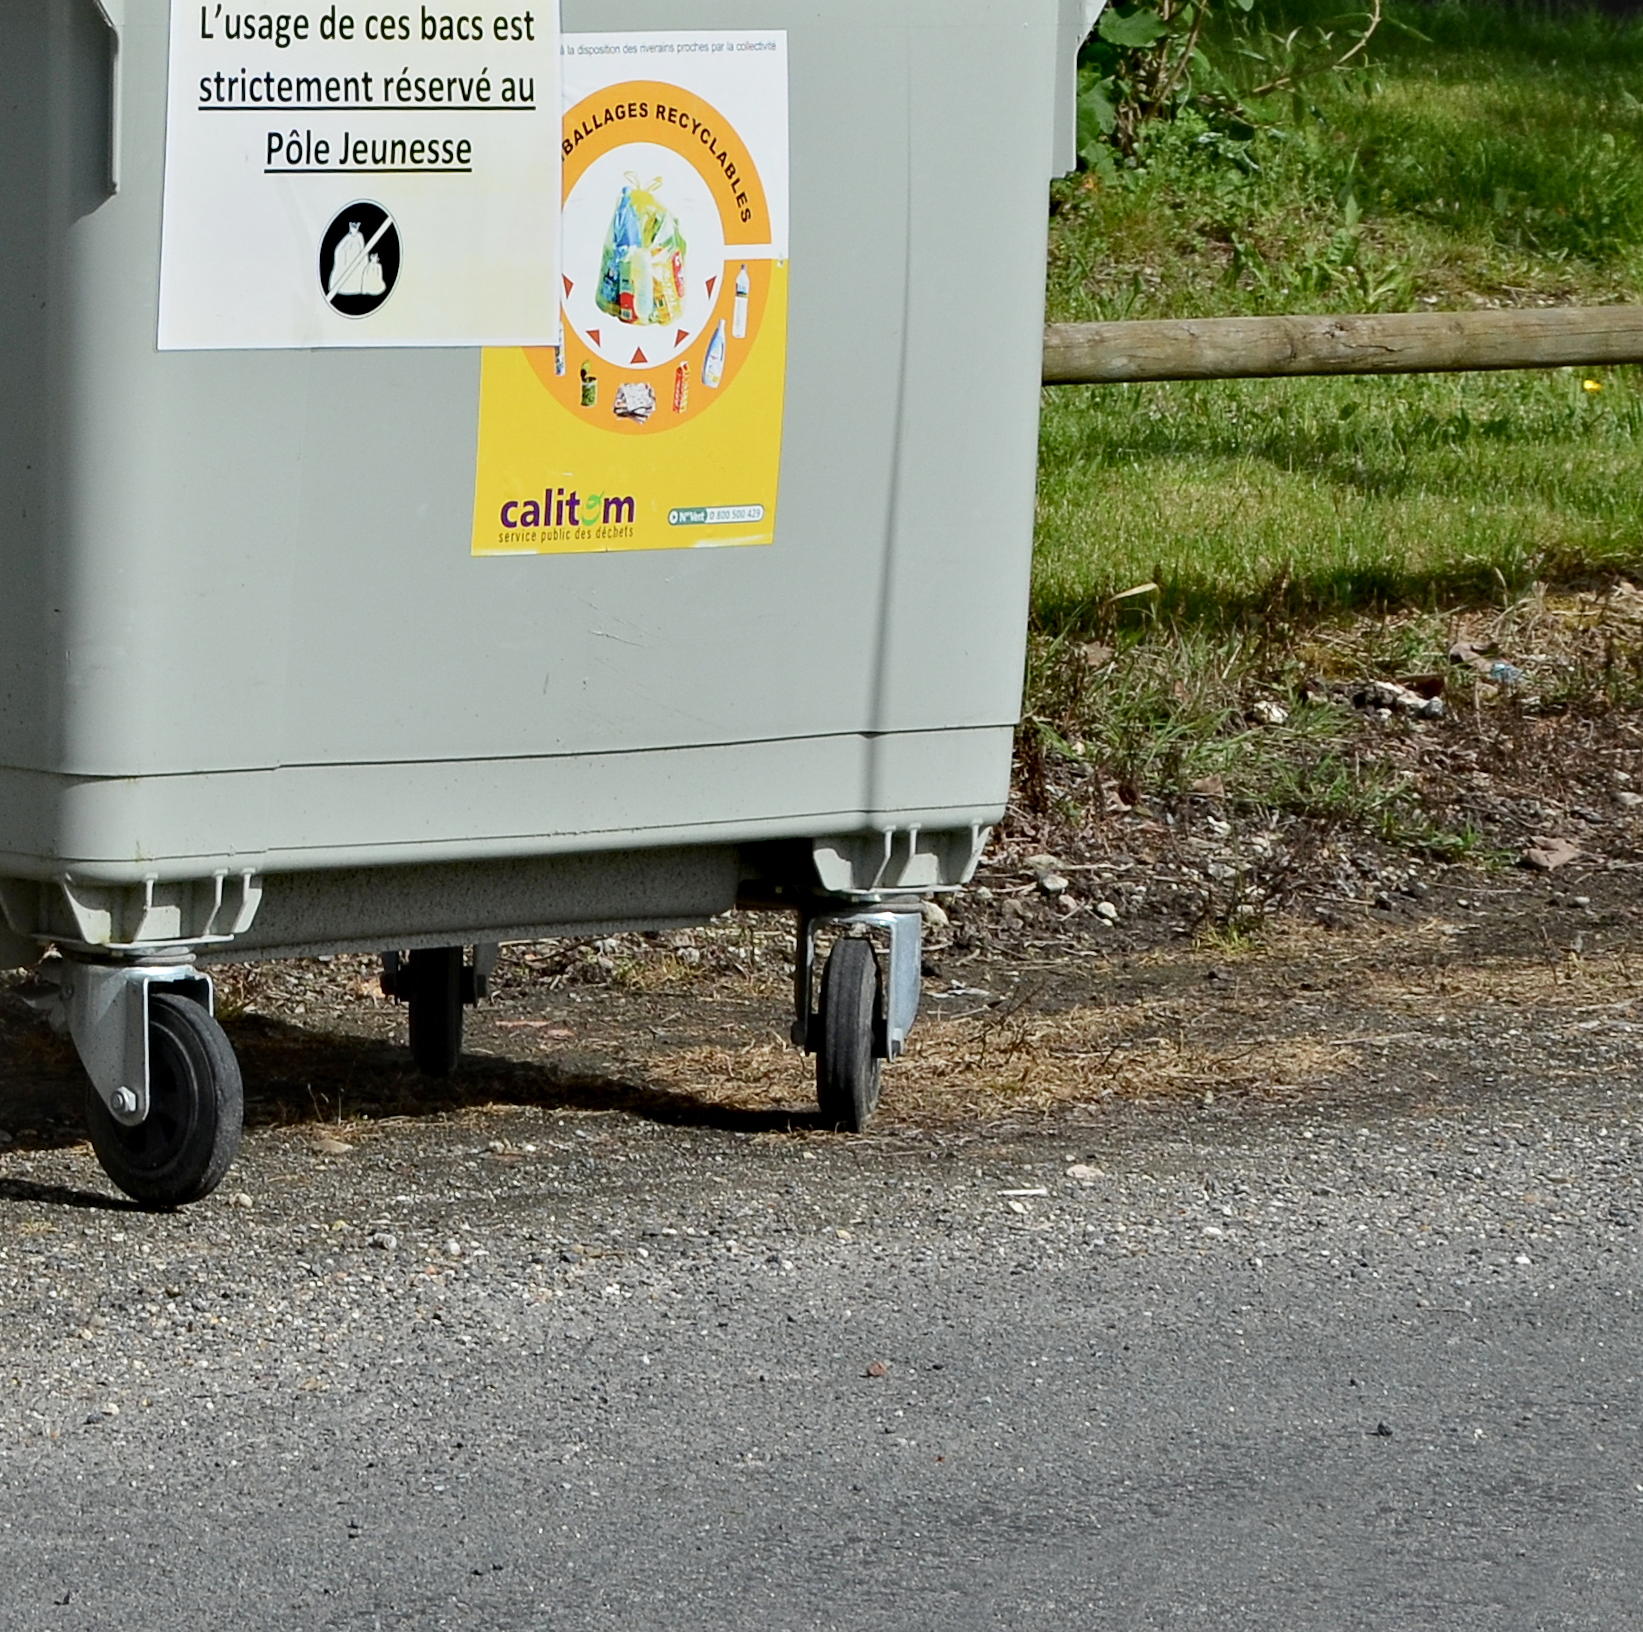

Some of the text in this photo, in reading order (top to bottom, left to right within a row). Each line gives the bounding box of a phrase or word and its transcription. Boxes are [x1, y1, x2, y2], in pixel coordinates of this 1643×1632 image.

[200, 4, 535, 48] L'usage de ces bacs est
[567, 45, 575, 55] la
[577, 43, 620, 56] disposition
[622, 43, 638, 54] des
[640, 43, 675, 54] riverains
[677, 42, 710, 55] proches
[711, 43, 725, 55] par
[727, 42, 734, 52] la
[736, 40, 777, 53] collectivité
[199, 67, 534, 102] strictement réservé au
[266, 129, 472, 165] Pôle Jeunesse
[561, 102, 752, 223] BALLAGES RECYCLABLES
[498, 526, 634, 543] service public des déchets
